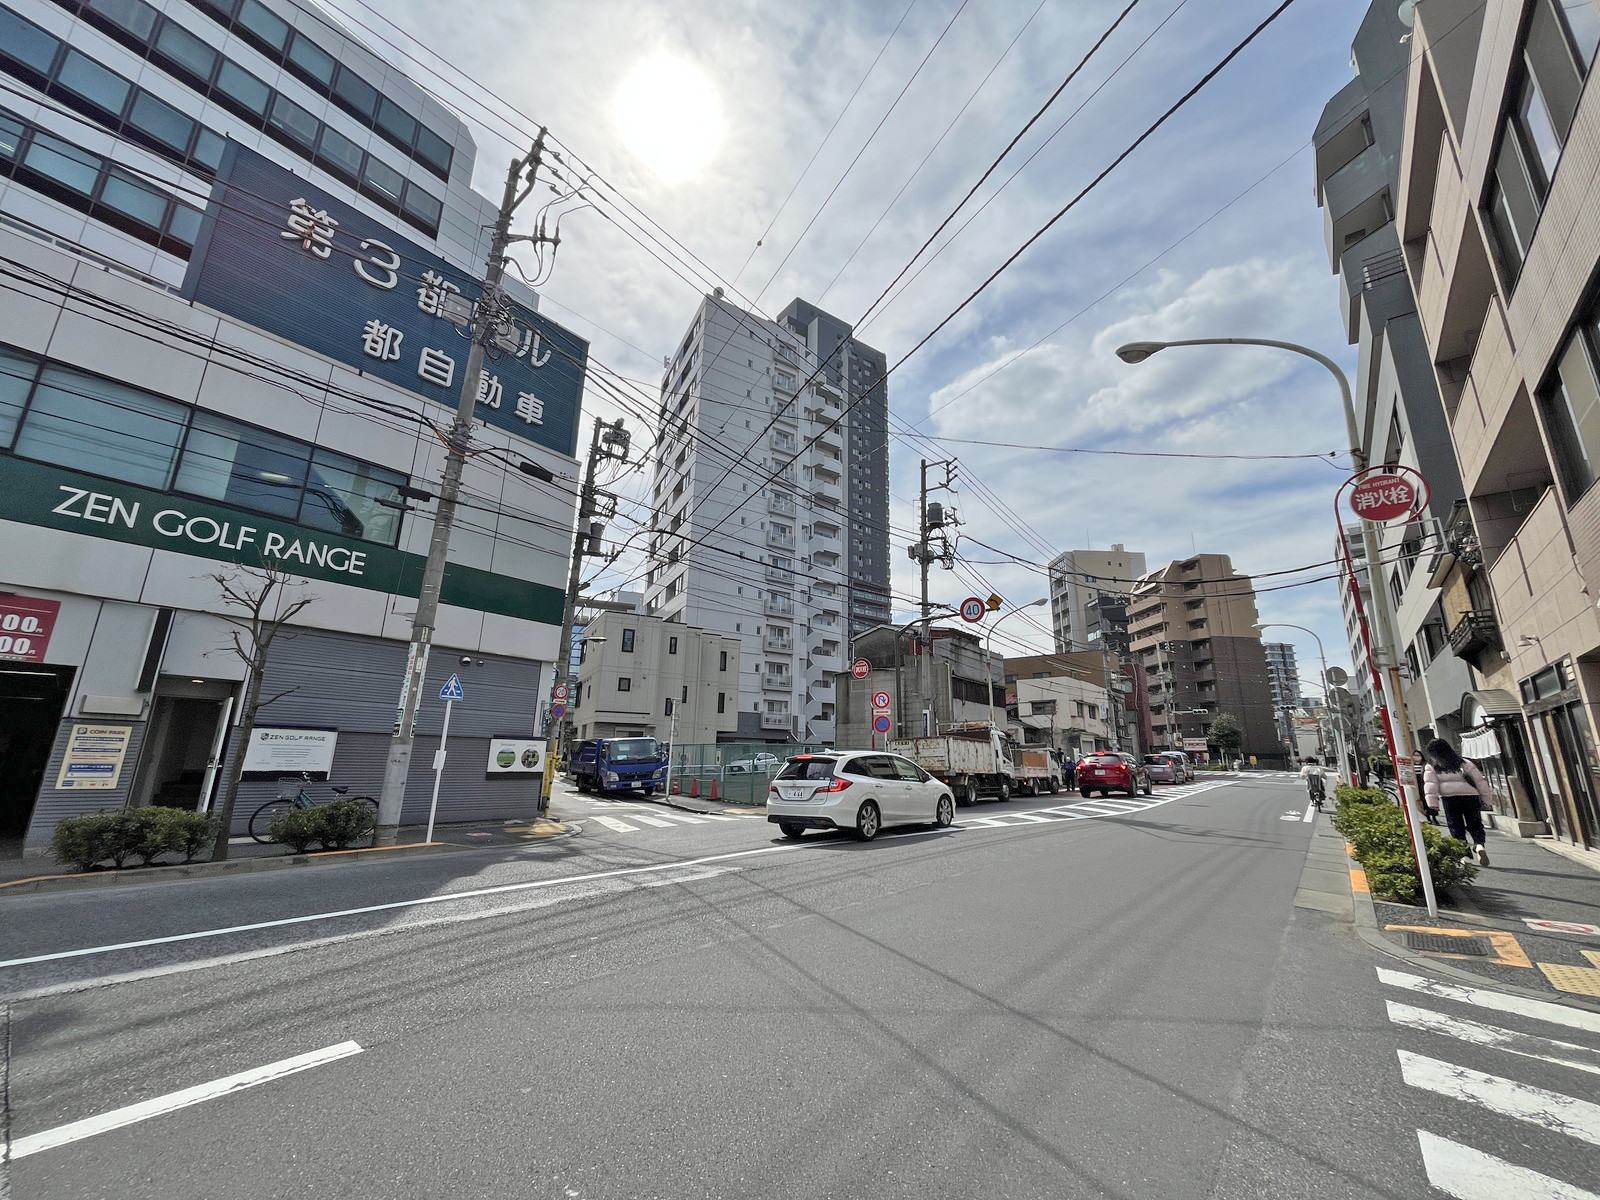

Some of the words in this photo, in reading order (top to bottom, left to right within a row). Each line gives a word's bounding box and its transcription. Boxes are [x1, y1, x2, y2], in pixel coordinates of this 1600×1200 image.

[361, 319, 545, 425] 都自動車
[1372, 477, 1400, 488] HYDRANT
[1355, 484, 1411, 511] 消火栓
[51, 485, 140, 529] ZEN
[152, 509, 257, 551] GOLF
[263, 531, 367, 575] RANGE
[966, 604, 980, 616] 40
